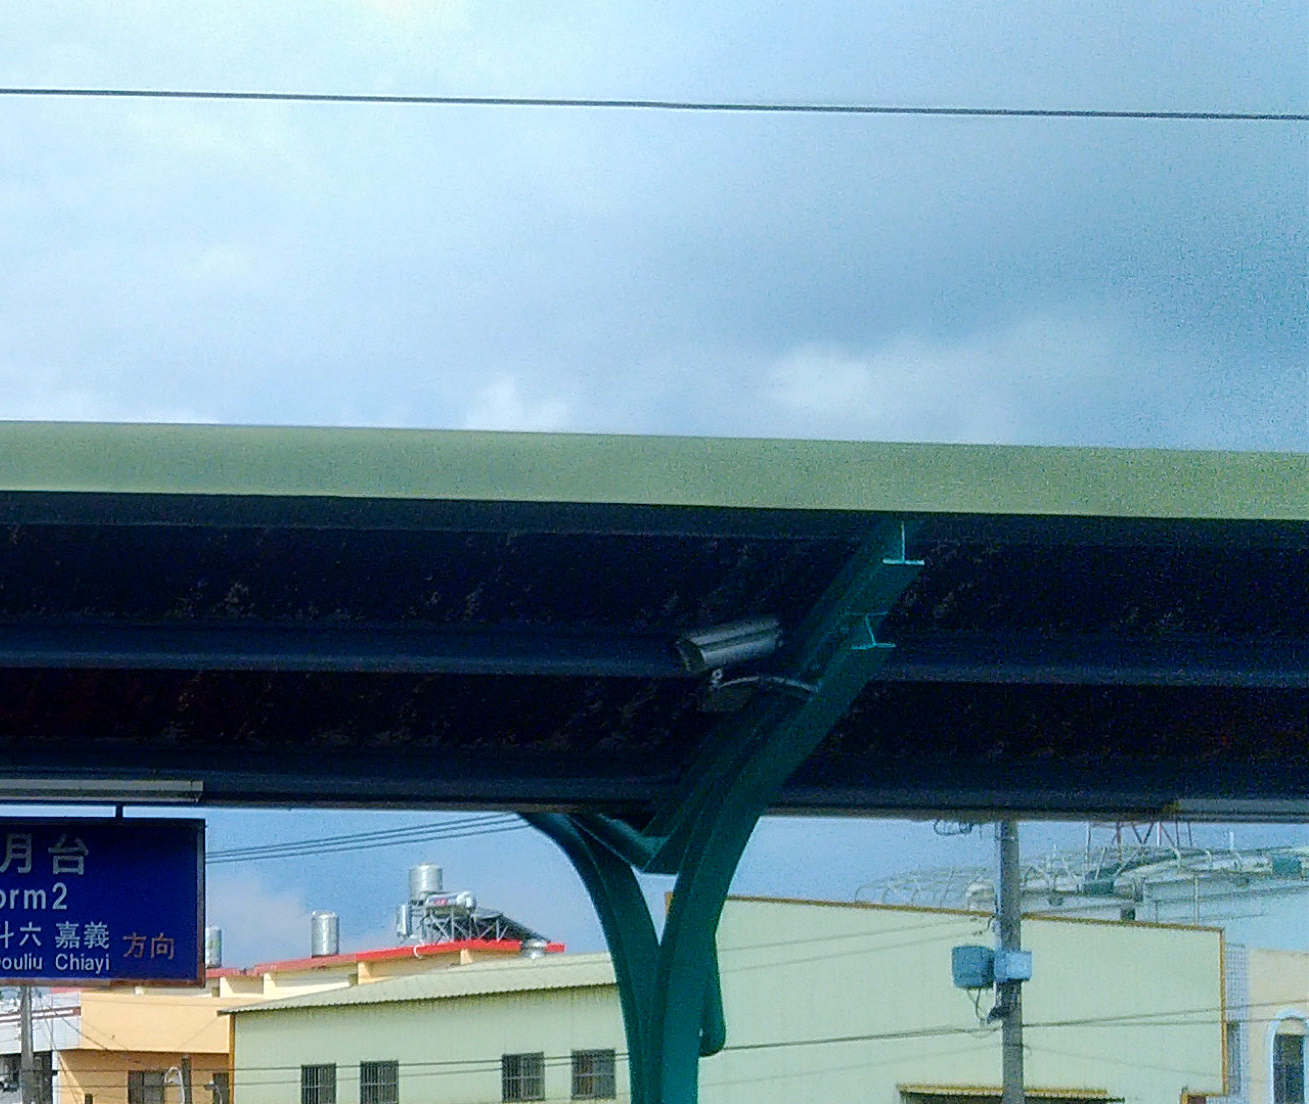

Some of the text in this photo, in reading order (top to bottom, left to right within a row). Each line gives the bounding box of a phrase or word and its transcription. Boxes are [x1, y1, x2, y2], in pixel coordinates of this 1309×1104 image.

[55, 921, 109, 949] 嘉義
[123, 933, 174, 959] 方向
[56, 953, 109, 974] Chiayi
